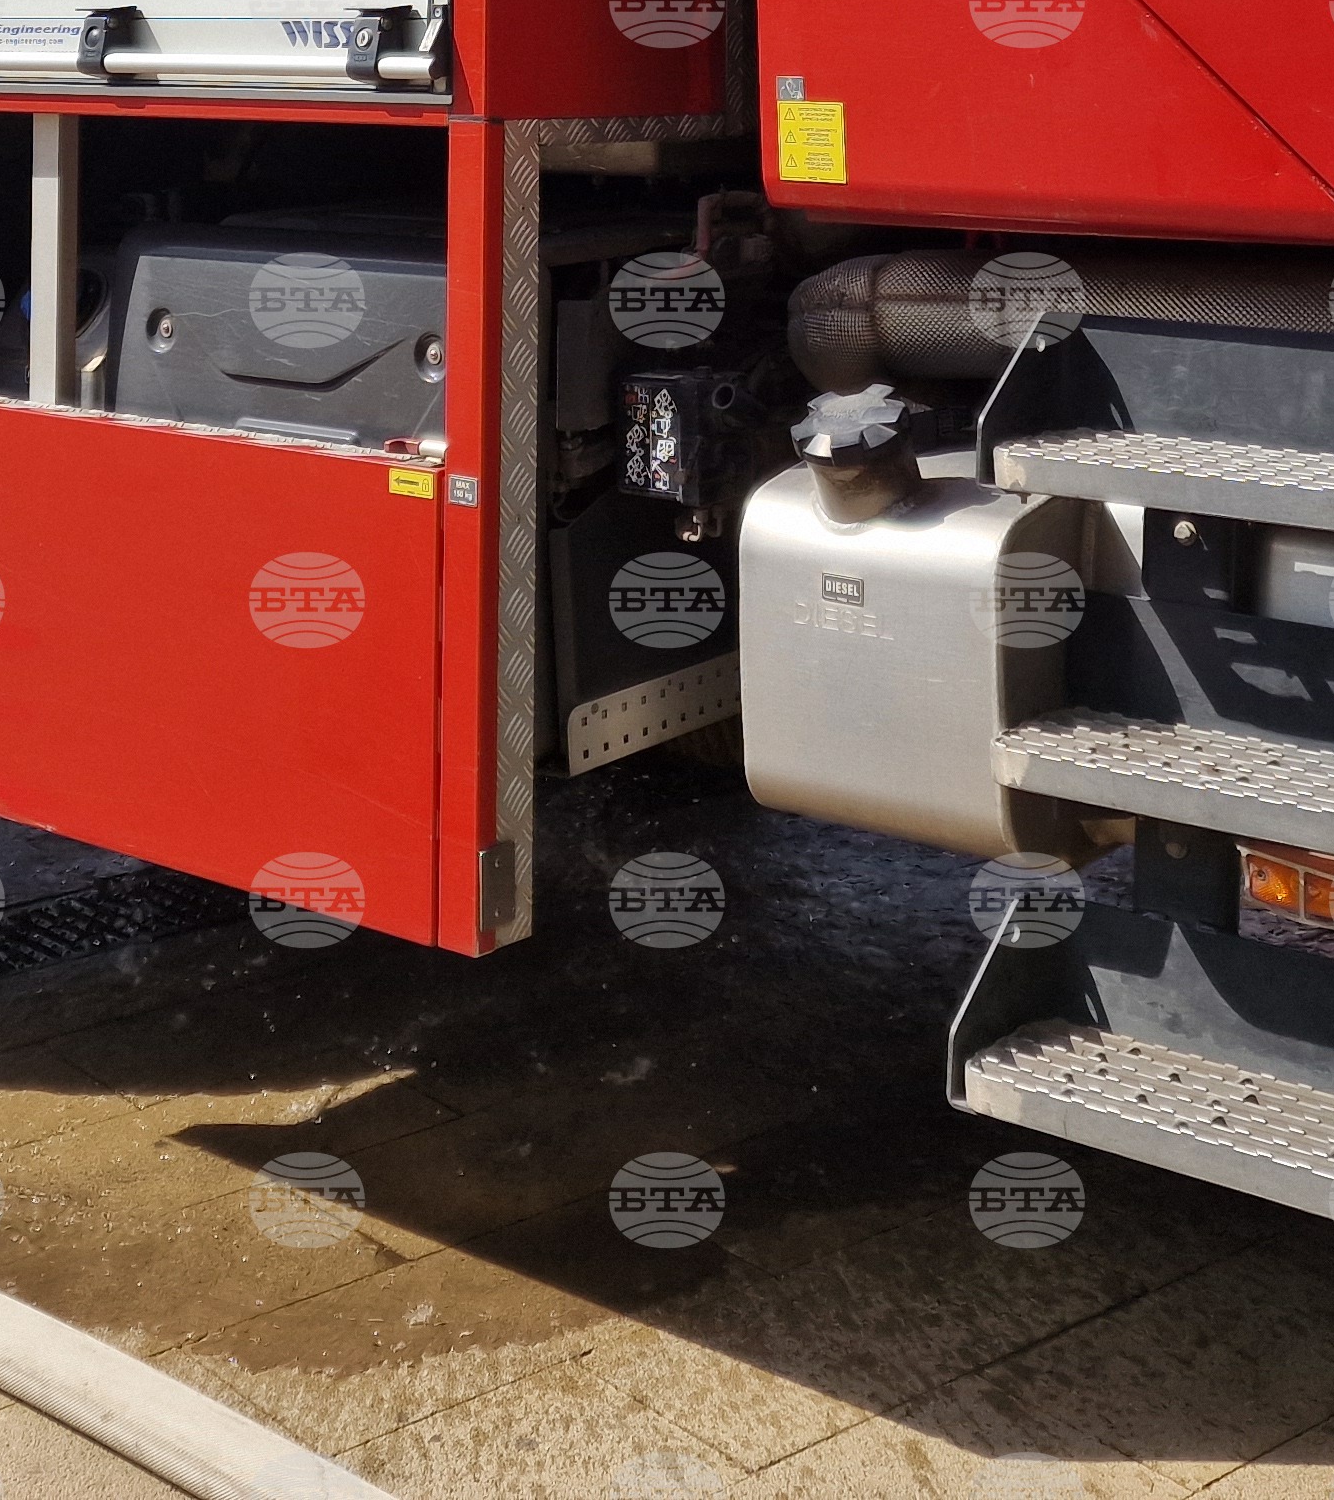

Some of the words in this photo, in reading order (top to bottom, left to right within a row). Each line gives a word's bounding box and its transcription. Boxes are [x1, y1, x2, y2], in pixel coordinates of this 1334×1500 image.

[455, 480, 471, 490] MAX
[825, 579, 860, 597] DIESEL
[793, 600, 895, 641] DIESEL
